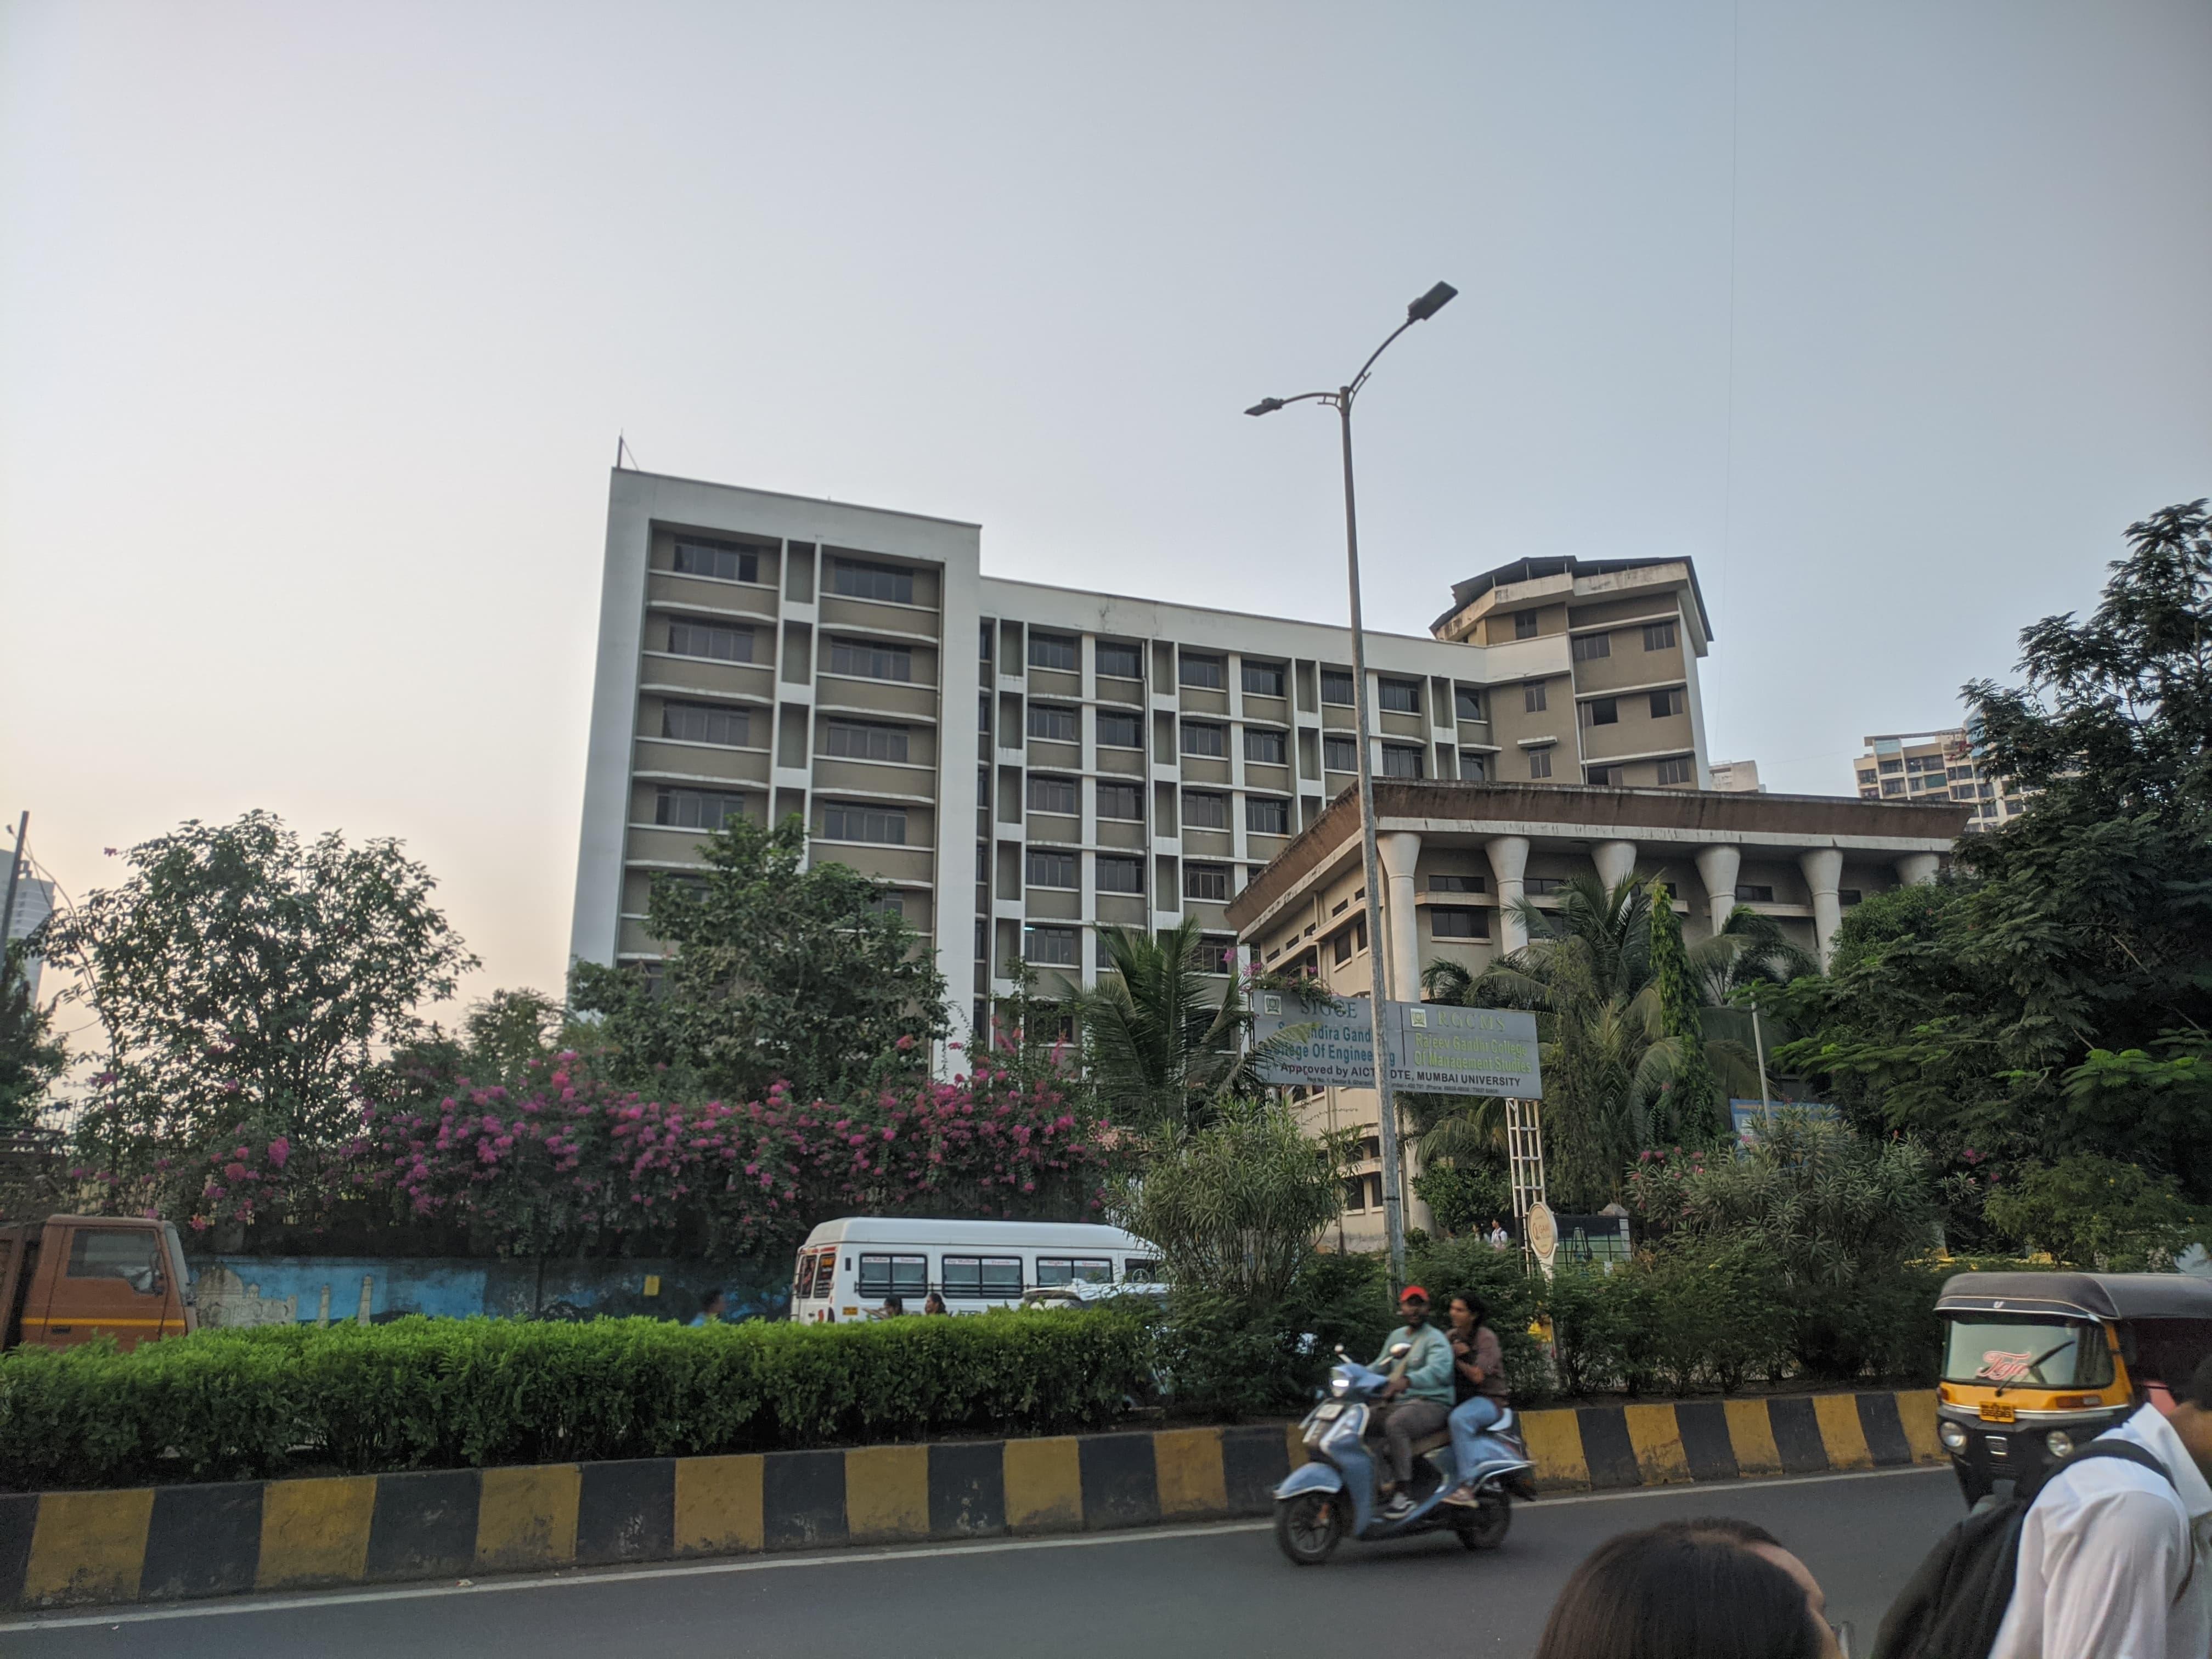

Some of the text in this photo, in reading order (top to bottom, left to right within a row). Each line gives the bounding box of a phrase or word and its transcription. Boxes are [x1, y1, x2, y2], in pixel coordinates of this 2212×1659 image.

[1437, 1011, 1505, 1032] RGCMS
[1308, 1024, 1372, 1042] ndira Gand
[1312, 1043, 1326, 1058] Of
[1329, 1045, 1395, 1066] Engineeg
[1415, 1032, 1528, 1057] Rajeev Gandhi College
[1414, 1051, 1531, 1073] Of Management Studies
[1281, 1063, 1520, 1086] Approved by AICT DTE, MUMBAI UNIVERSITY
